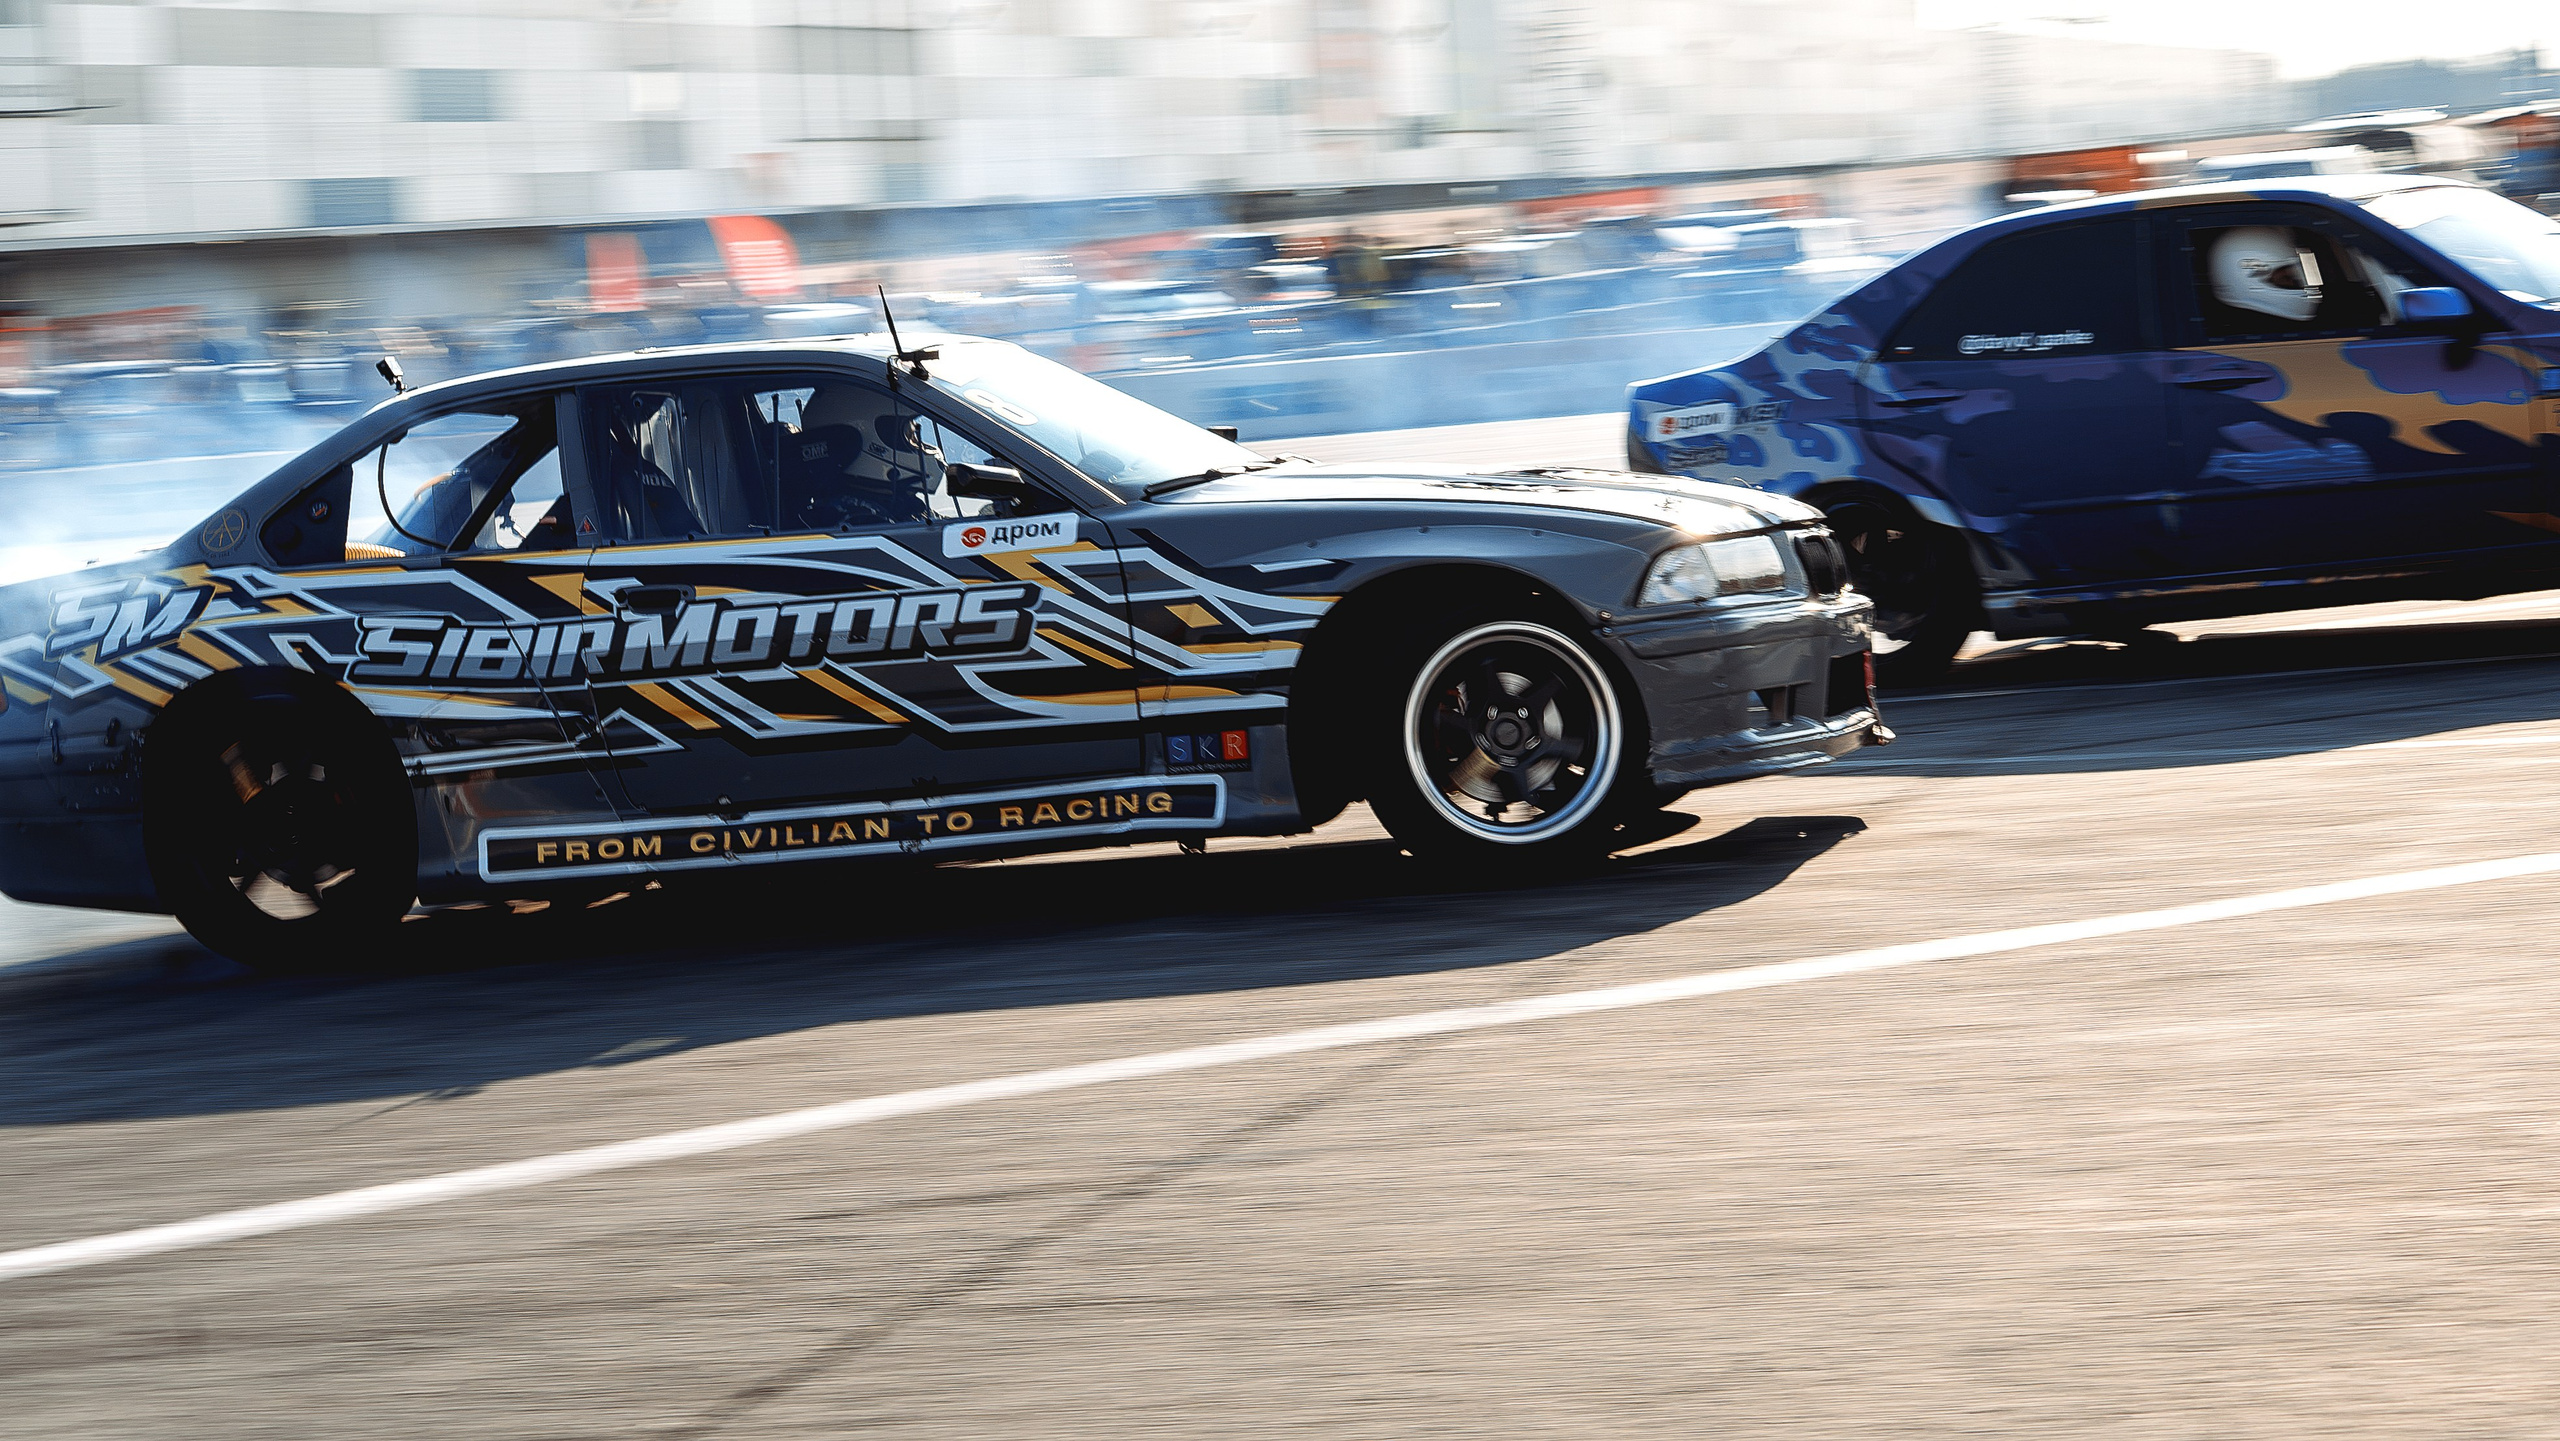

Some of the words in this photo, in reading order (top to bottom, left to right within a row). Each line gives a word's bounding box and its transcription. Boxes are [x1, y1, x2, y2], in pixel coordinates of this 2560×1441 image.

[962, 388, 1039, 426] 8
[991, 521, 1061, 546] дром
[51, 580, 201, 658] SM
[1171, 733, 1244, 761] SKR
[536, 834, 662, 864] FROM
[689, 816, 890, 854] CIVILIAN
[917, 811, 974, 835] TO
[999, 791, 1173, 828] RACING
